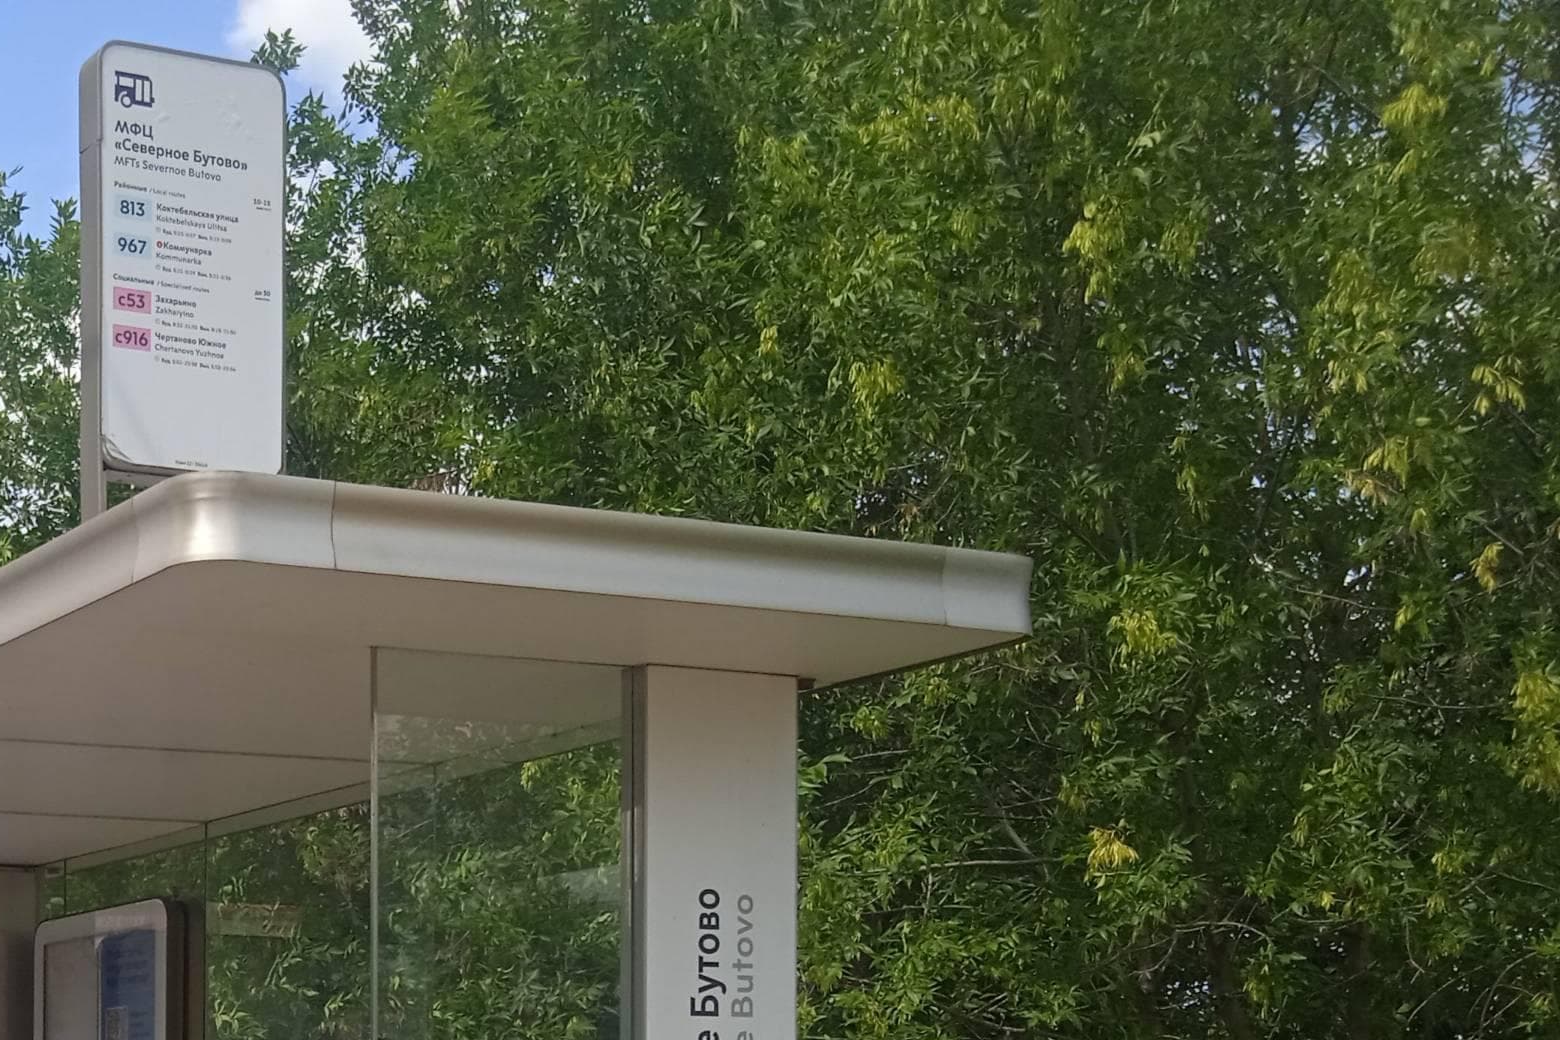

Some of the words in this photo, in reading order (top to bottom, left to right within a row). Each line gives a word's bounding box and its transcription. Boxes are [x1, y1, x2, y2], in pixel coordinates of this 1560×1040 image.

[115, 120, 154, 140] МФЦ
[115, 138, 189, 161] «Северное
[193, 150, 248, 171] Бутово»
[114, 156, 140, 169] MFTs
[142, 160, 186, 176] Severnoe
[189, 167, 221, 182] Butovo
[120, 200, 145, 217] 813
[215, 213, 239, 224] улица
[117, 237, 147, 254] 967
[690, 888, 727, 1018] Бутово
[730, 894, 755, 1018] Butovo
